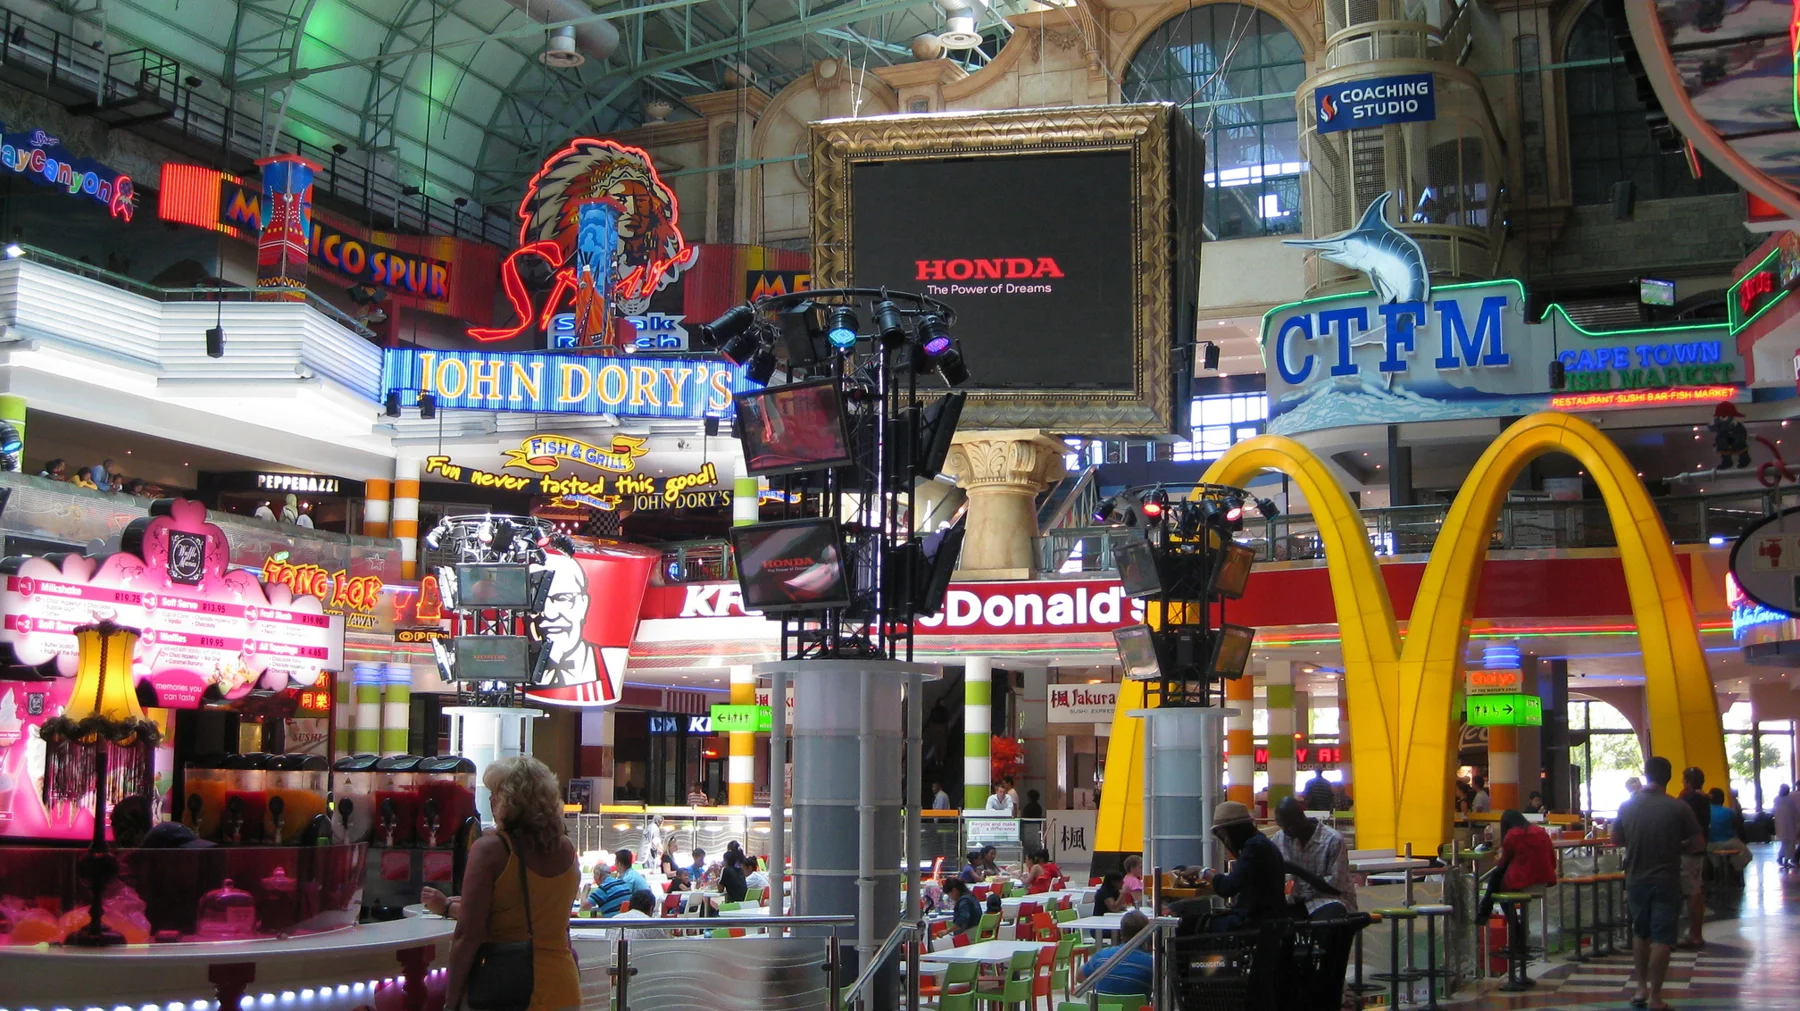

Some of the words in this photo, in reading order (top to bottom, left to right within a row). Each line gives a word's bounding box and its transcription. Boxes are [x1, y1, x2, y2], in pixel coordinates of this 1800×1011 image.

[1340, 82, 1428, 103] COACHING
[1352, 100, 1418, 119] STUDIO
[0, 133, 112, 203] ayCanyon
[227, 188, 366, 275] MICO
[370, 252, 448, 297] SPUR
[915, 257, 1065, 281] HONDA
[927, 285, 948, 295] The
[951, 284, 989, 295] Power
[990, 283, 1003, 294] of
[1005, 283, 1052, 294] Dreams
[555, 316, 678, 331] Sak
[555, 335, 682, 350] Rch
[1276, 296, 1510, 385] CTFM
[1558, 346, 1630, 372] CAPE
[1635, 341, 1721, 367] TOWN
[420, 352, 544, 401] JOHN
[557, 363, 733, 410] DORY'S
[1552, 370, 1611, 393] ISH
[1620, 363, 1735, 388] MARKET
[1694, 387, 1735, 399] MARKET
[530, 438, 571, 456] FISH
[571, 444, 583, 458] &
[584, 447, 627, 470] GRILL
[258, 474, 339, 493] PEPPERAZZI
[426, 455, 462, 481] Fun
[471, 468, 530, 492] never
[539, 474, 605, 497] tasted
[614, 473, 655, 495] this
[664, 462, 718, 502] good!
[632, 493, 671, 512] JOHN
[675, 490, 731, 509] DORY'S
[762, 557, 815, 569] HONDA
[41, 582, 82, 595] Milkshake
[114, 592, 140, 604] R19.75
[262, 557, 328, 602] TONG
[330, 569, 384, 612] LOK
[202, 603, 226, 613] R13.95
[903, 586, 1145, 627] cDonald's
[38, 620, 55, 629] Soft
[302, 616, 324, 625] R19.90
[200, 637, 224, 647] R19.95
[156, 682, 188, 693] memories
[189, 685, 202, 693] you
[178, 693, 195, 702] taste
[292, 733, 322, 741] SUSHI
[1061, 825, 1087, 851] 楓
